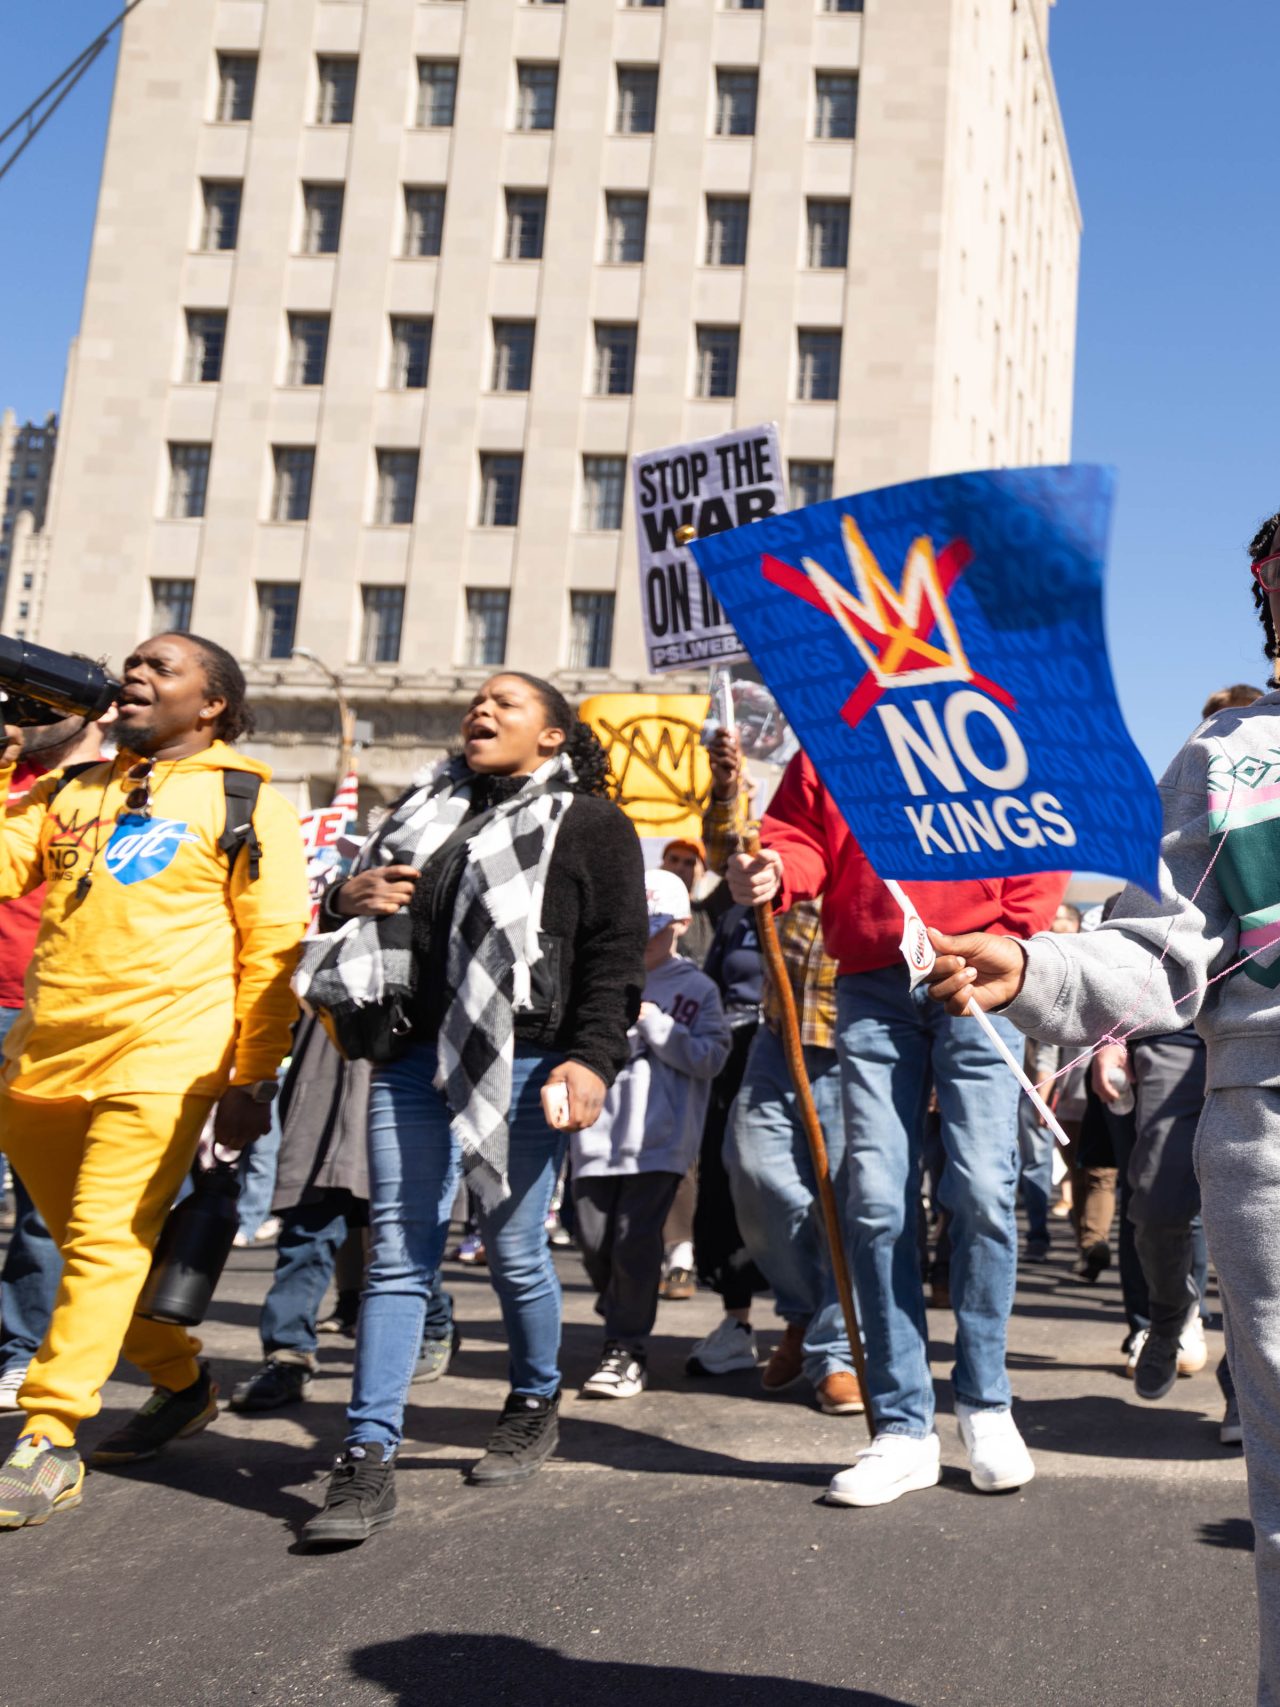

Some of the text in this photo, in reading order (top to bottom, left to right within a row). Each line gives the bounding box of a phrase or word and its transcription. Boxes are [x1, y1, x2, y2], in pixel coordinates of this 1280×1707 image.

[639, 437, 773, 508] STOP THE
[647, 561, 692, 637] ON
[654, 634, 744, 665] PSLWEB.
[875, 690, 1029, 796] NO
[107, 820, 200, 875] aft
[903, 791, 1078, 855] KINGS
[48, 849, 79, 870] NO
[671, 993, 699, 1027] 19
